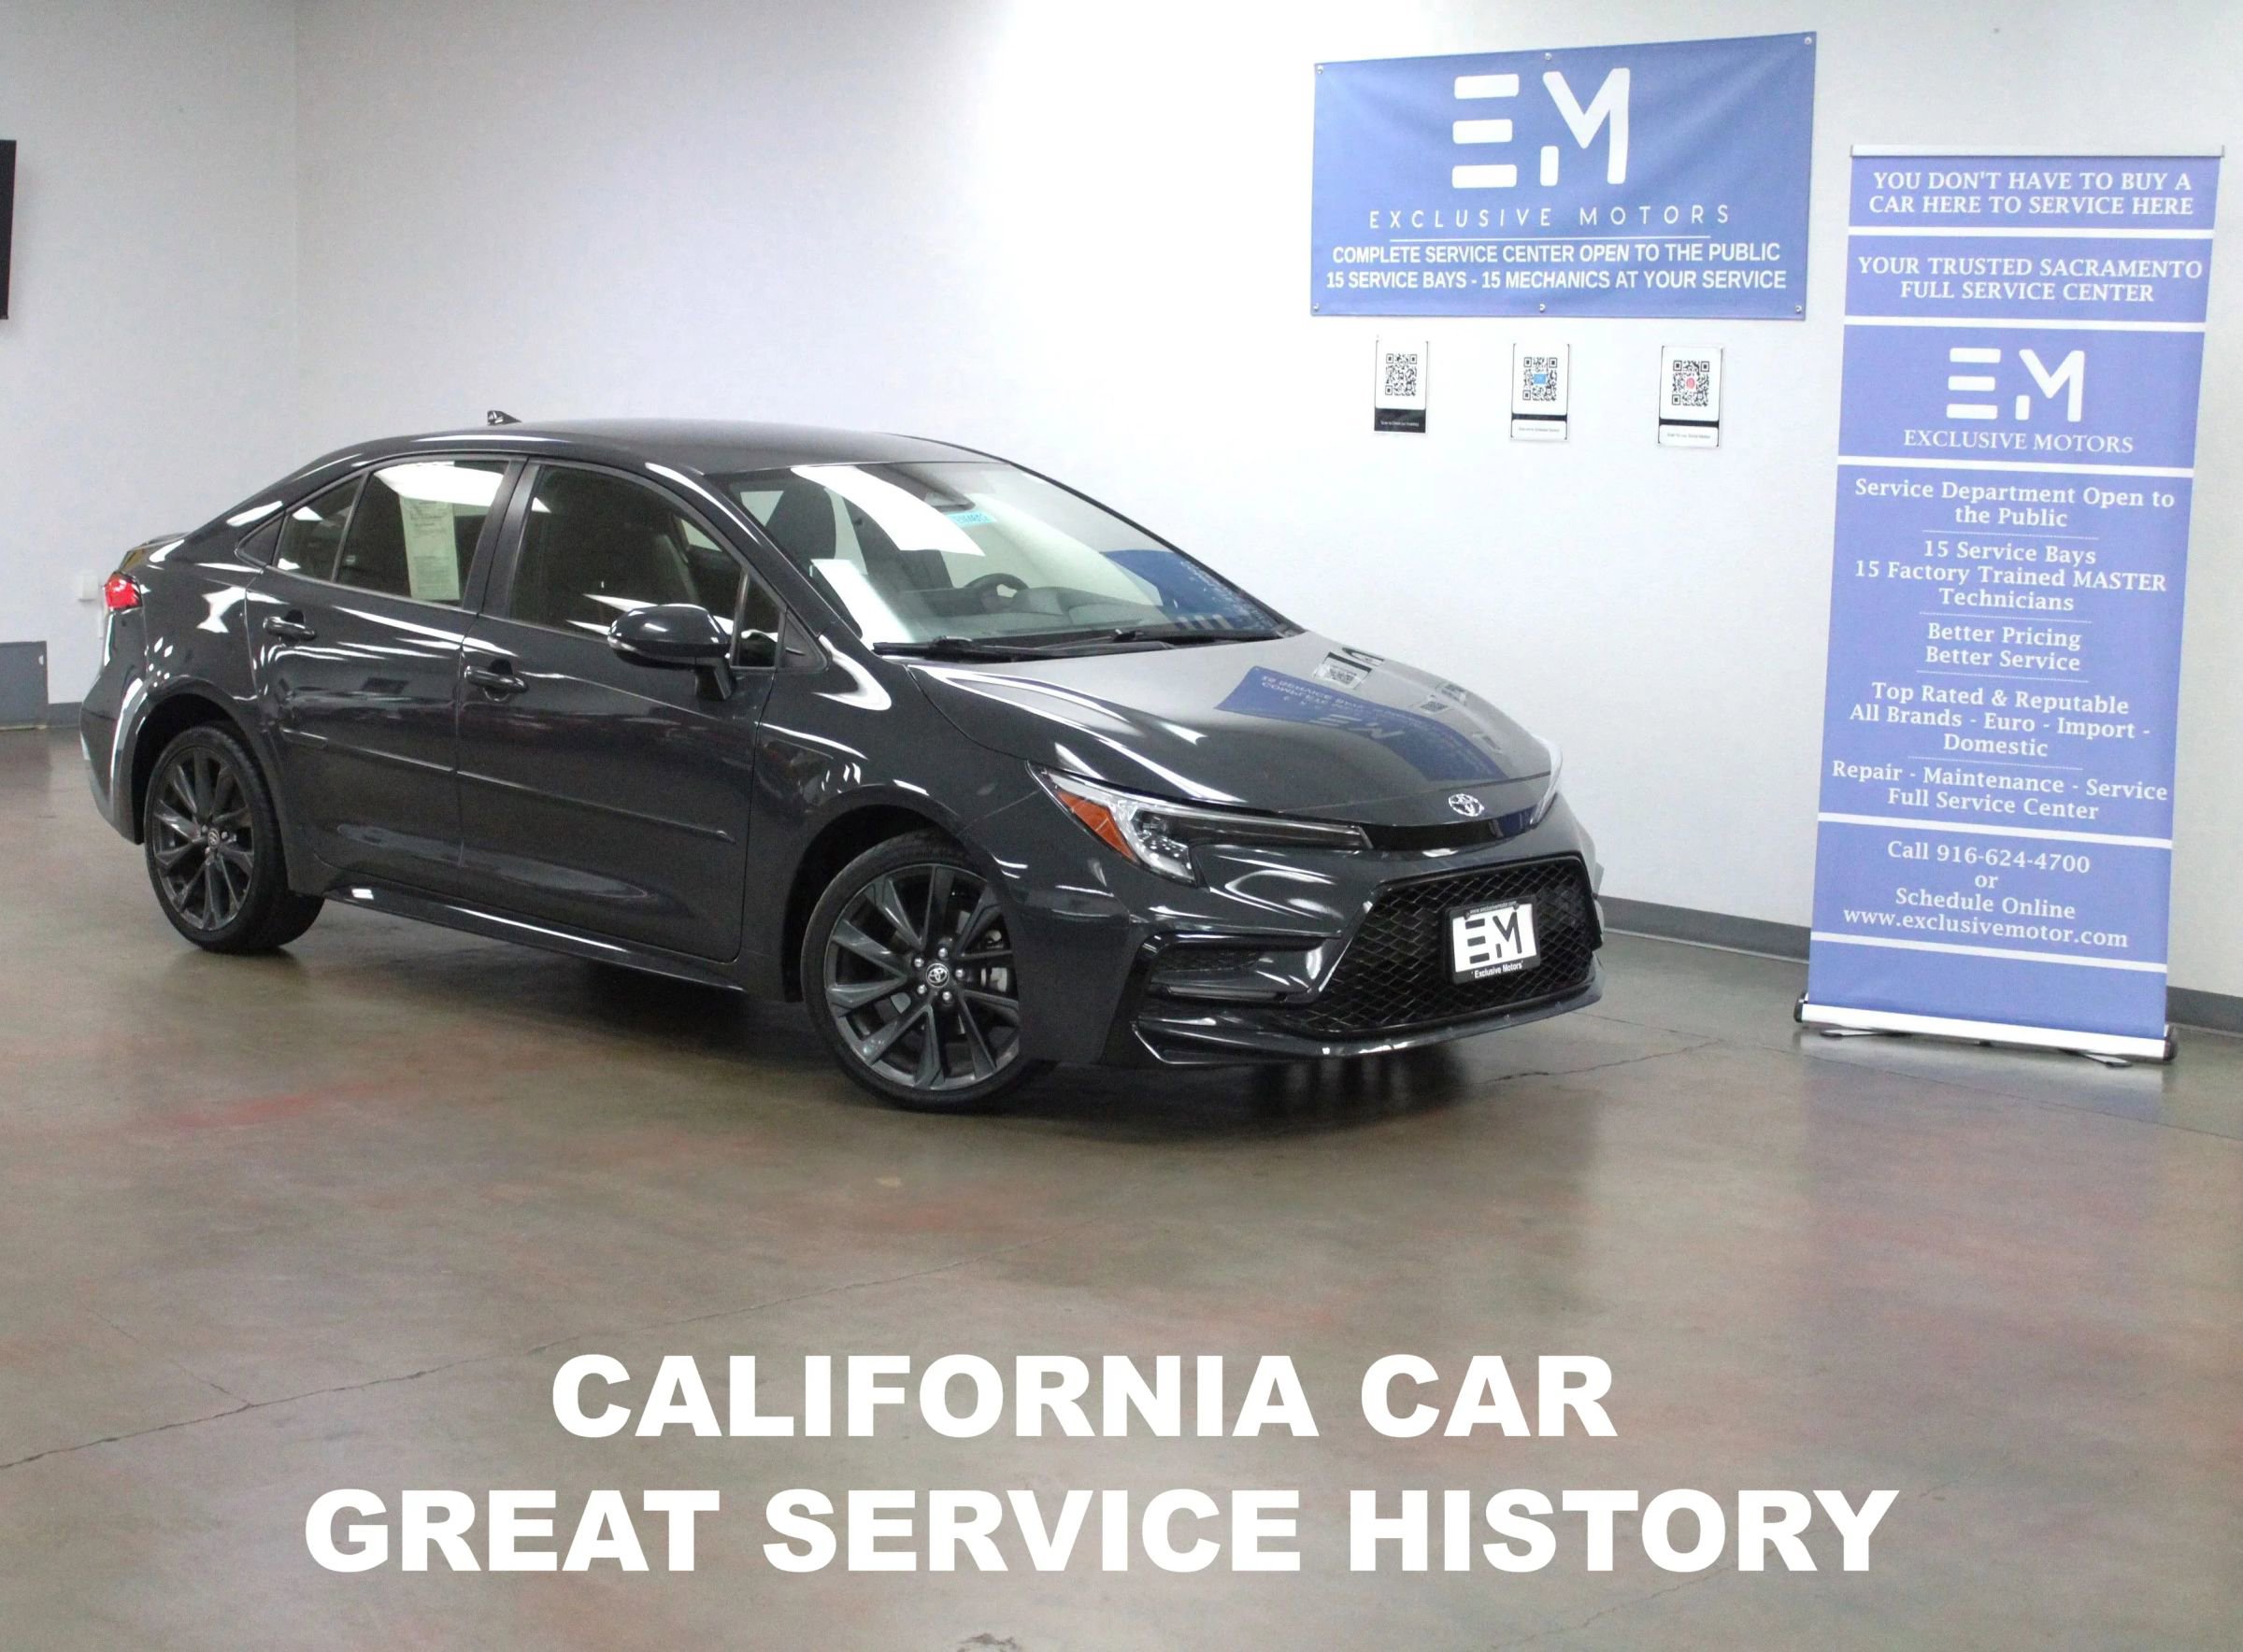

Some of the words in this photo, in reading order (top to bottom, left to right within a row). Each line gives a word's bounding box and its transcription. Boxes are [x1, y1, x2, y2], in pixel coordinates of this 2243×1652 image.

[1451, 67, 1631, 189] EM
[1873, 172, 1922, 190] YOU
[1928, 171, 2002, 190] DON'T
[2008, 172, 2072, 190] HAVE
[2079, 172, 2113, 191] TO
[2121, 172, 2168, 191] BUY
[2175, 173, 2192, 191] A
[1369, 207, 1551, 229] EXCLUSIVE
[1579, 204, 1729, 225] MOTORS
[1869, 195, 1915, 213] CAR
[1922, 195, 1981, 213] HERE
[1988, 195, 2022, 214] TO
[2029, 195, 2124, 215] SERVICE
[2132, 196, 2193, 215] HERE
[1333, 246, 1421, 263] COMPLETE
[1424, 245, 1498, 263] SERVICE
[1502, 244, 1575, 263] CENTER
[1579, 244, 1630, 263] OPEN
[1634, 243, 1660, 262] TO
[1664, 243, 1704, 262] THE
[1708, 242, 1780, 262] PUBLIC
[1326, 271, 1345, 289] 15
[1348, 271, 1419, 289] SERVICE
[1422, 271, 1467, 289] BAYS
[1481, 270, 1501, 289] 15
[1505, 270, 1610, 289] MECHANICS
[1615, 270, 1639, 289] AT
[1643, 270, 1697, 289] YOUR
[1702, 269, 1787, 289] SERVICE
[1858, 256, 1920, 275] YOUR
[1927, 257, 2033, 276] TRUSTED
[2039, 258, 2203, 278] SACRAMENTO
[1900, 280, 1955, 299] FULL
[1962, 280, 2056, 300] SERVICE
[2063, 282, 2154, 302] CENTER
[1946, 347, 2085, 422] EM
[1904, 429, 2027, 449] EXCLUSIVE
[2033, 434, 2134, 453] MOTORS
[1855, 477, 1934, 498] Service
[1941, 481, 2076, 506] Department
[2083, 487, 2144, 509] Open
[2152, 491, 2175, 508] to
[1955, 505, 1991, 524] the
[1997, 507, 2067, 527] Public
[1924, 540, 1949, 558] 15
[1956, 541, 2037, 562] Service
[2045, 545, 2096, 567] Bays
[1855, 560, 1879, 577] 15
[1887, 561, 1970, 586] Factory
[1978, 565, 2065, 587] Trained
[2073, 570, 2166, 591] MASTER
[1938, 587, 2074, 611] Technicians
[1928, 622, 1995, 643] Better
[2002, 626, 2081, 652] Pricing
[1925, 645, 1993, 666] Better
[1999, 649, 2080, 672] Service
[1871, 681, 1914, 705] Top
[1921, 685, 1984, 705] Rated
[1991, 689, 2008, 706] &
[2015, 691, 2129, 715] Reputable
[1850, 703, 1879, 722] All
[1886, 705, 1963, 727] Brands
[1983, 712, 2036, 733] Euro
[2057, 717, 2136, 740] Import
[1943, 733, 2049, 757] Domestic
[1833, 760, 1903, 783] Repair
[1922, 766, 2064, 794] Maintenance
[2086, 778, 2167, 801] Service
[1888, 787, 1929, 807] Full
[1936, 790, 2016, 814] Service
[2023, 797, 2099, 819] Center
[1887, 840, 1929, 861] Call
[1936, 844, 2091, 874] 916-624-4700
[1974, 875, 1999, 890] or
[1895, 887, 1994, 913] Schedule
[2002, 897, 2076, 919] Online
[1464, 911, 1522, 964] EM
[1843, 909, 2130, 949] www.exclusivemotor.com
[1474, 965, 1502, 979] Exclusive
[1502, 961, 1522, 973] Motors
